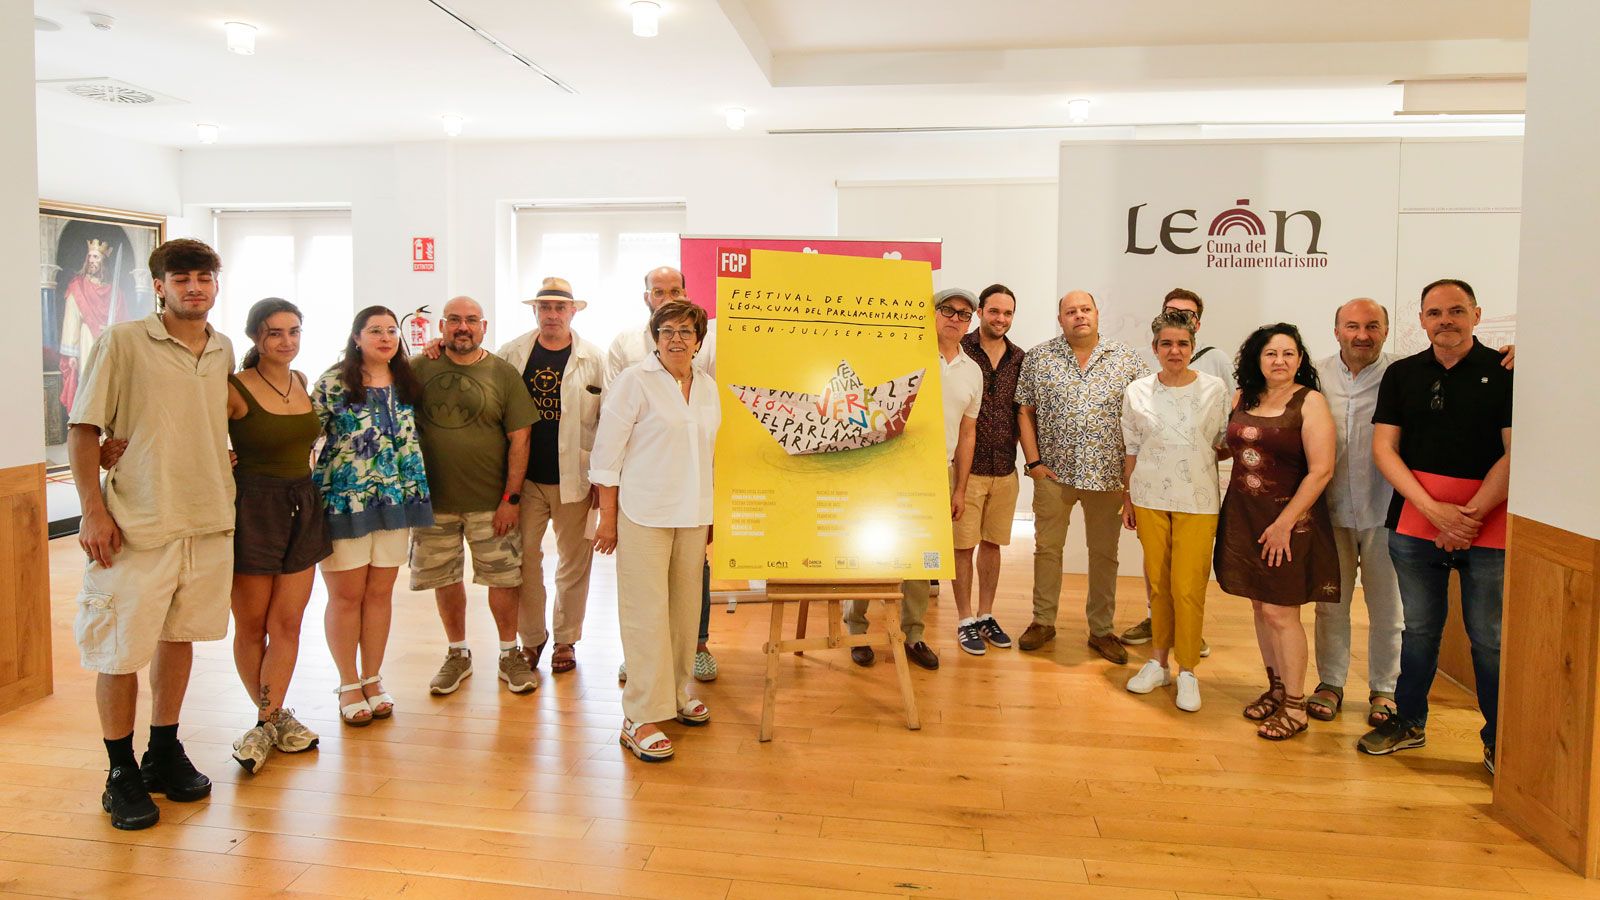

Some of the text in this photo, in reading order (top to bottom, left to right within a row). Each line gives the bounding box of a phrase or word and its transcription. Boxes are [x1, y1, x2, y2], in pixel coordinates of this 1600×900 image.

[1207, 239, 1266, 253] Cuna del
[721, 252, 747, 272] FCP
[1207, 254, 1328, 268] Parlamentarismo
[732, 290, 812, 301] FESTIVAL
[856, 296, 925, 308] VERANO
[767, 304, 799, 313] CUNA
[805, 307, 821, 315] DEL
